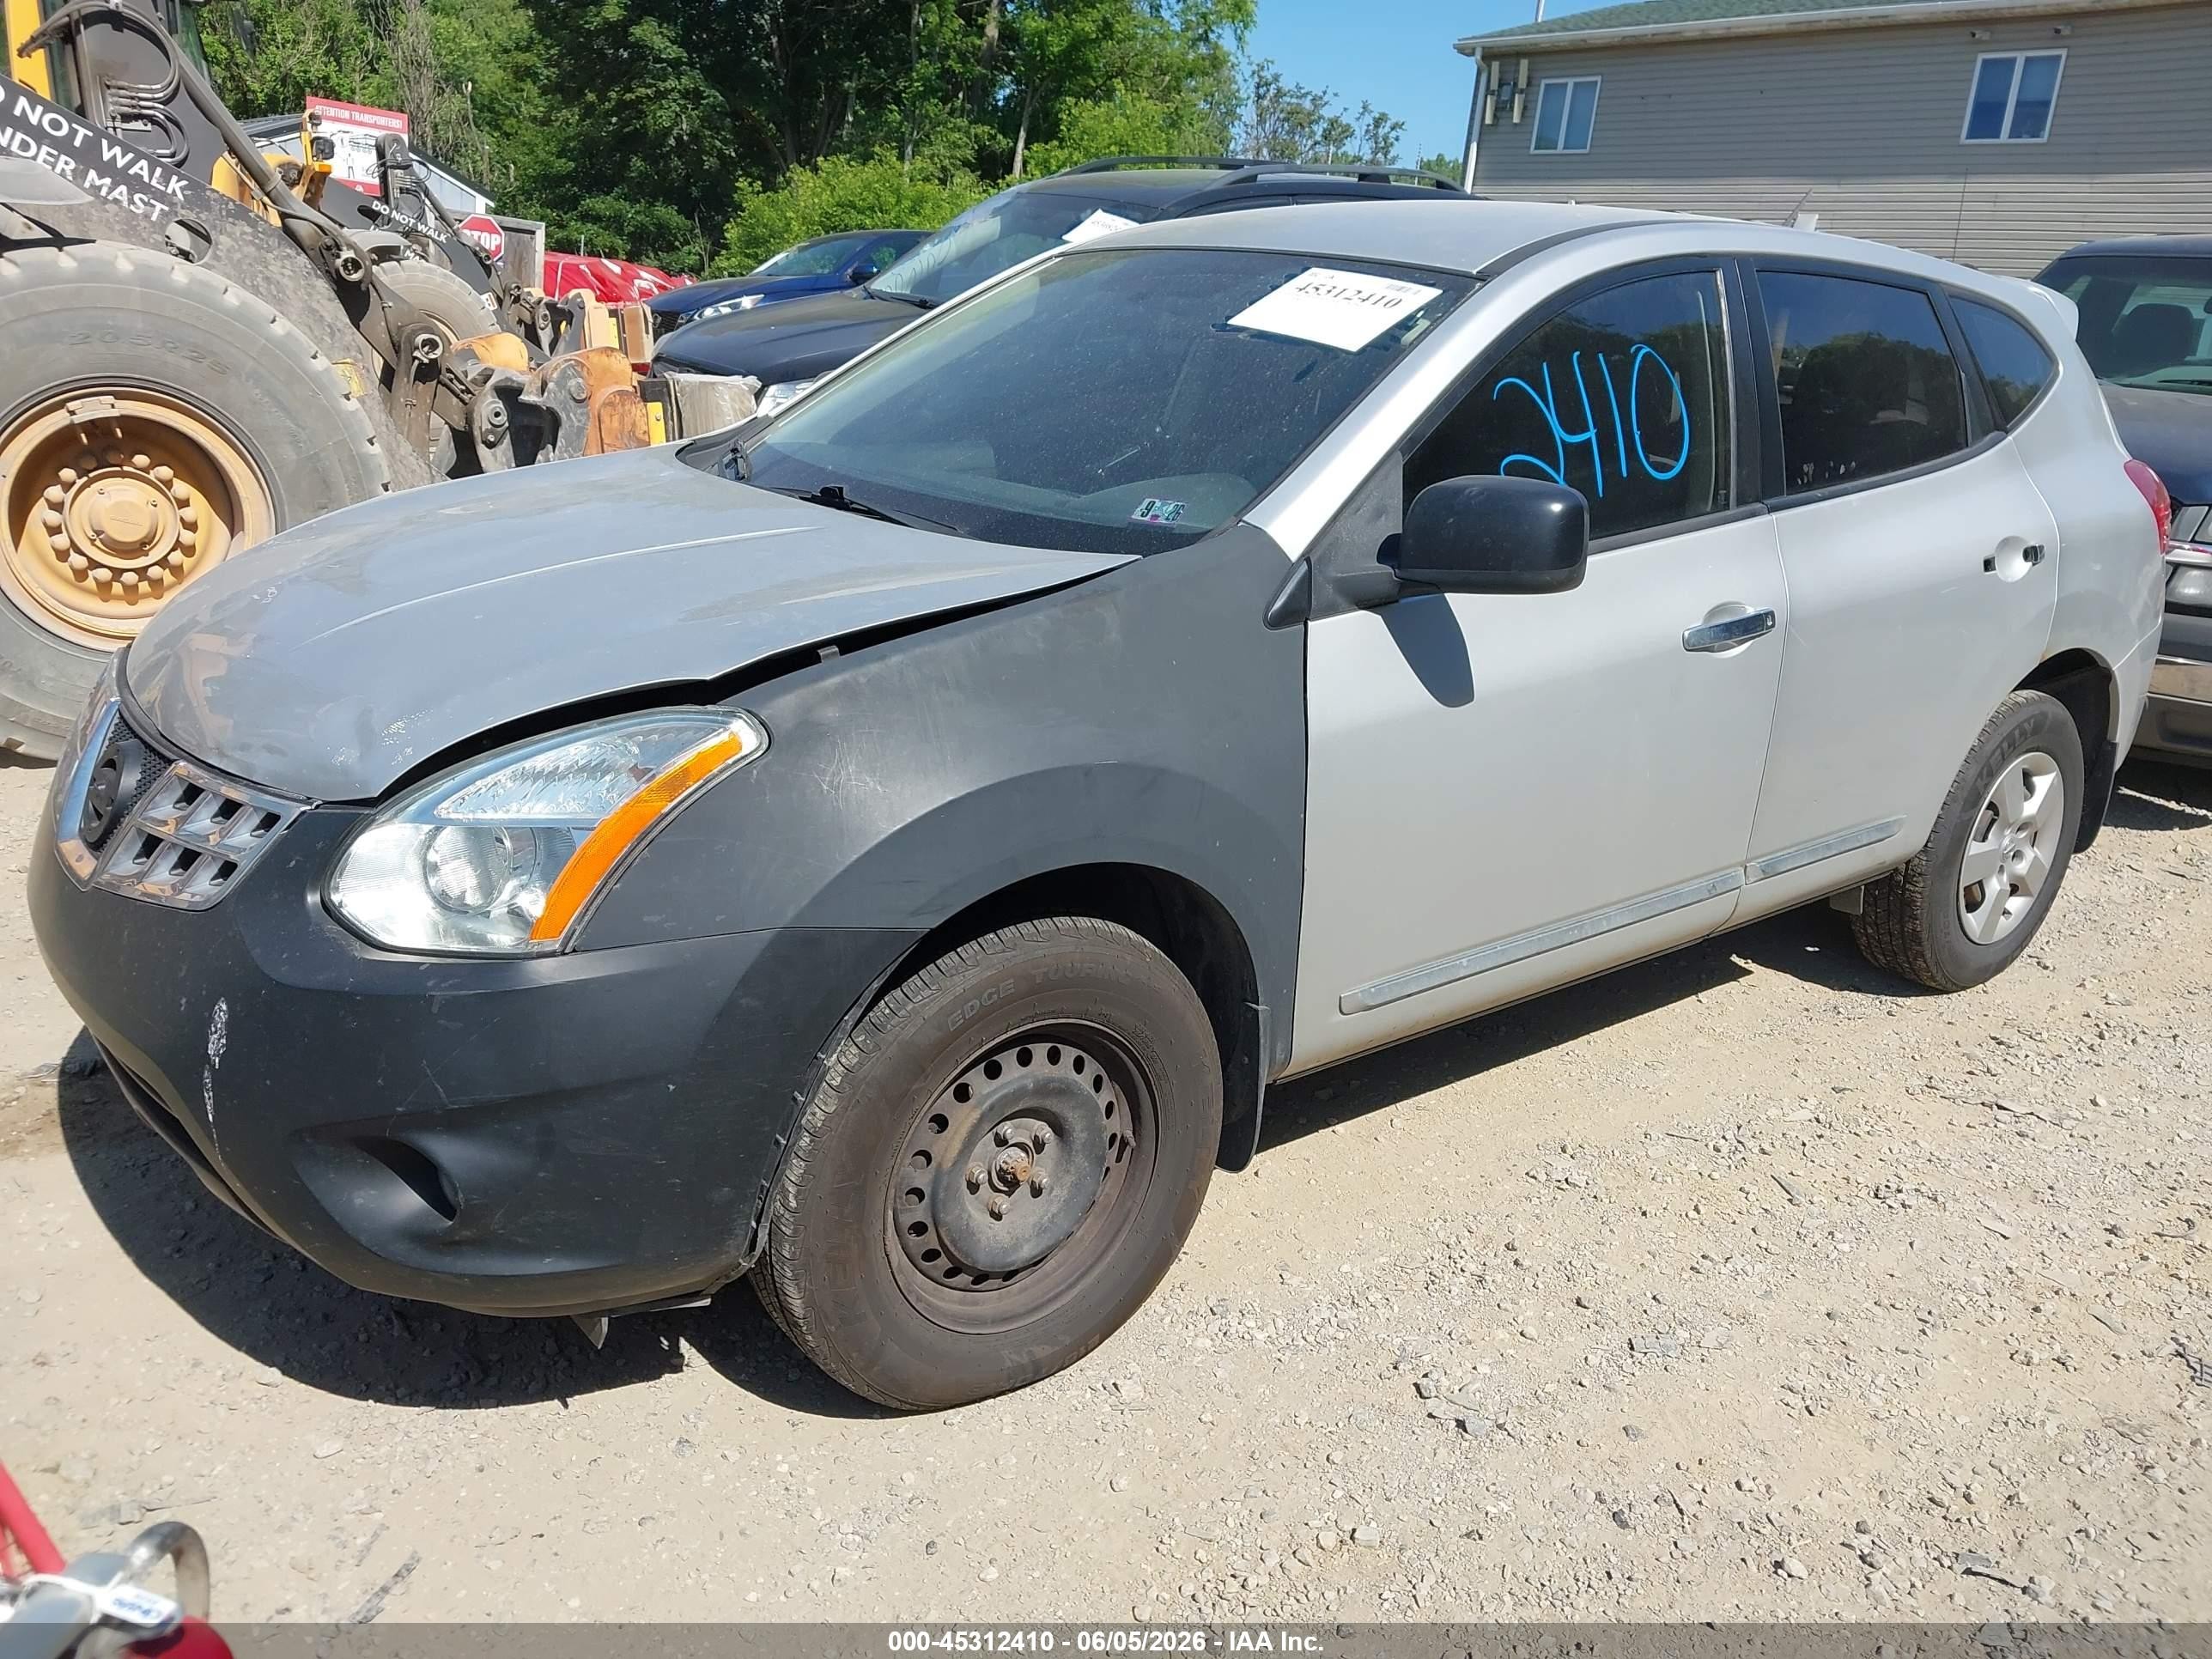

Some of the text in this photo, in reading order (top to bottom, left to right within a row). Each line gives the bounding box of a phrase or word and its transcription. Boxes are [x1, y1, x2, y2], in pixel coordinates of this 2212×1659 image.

[315, 105, 403, 129] ATTENTION TRANSPORTERS!
[14, 95, 189, 201] NOT WALK
[0, 126, 169, 222] NDER MAST
[372, 201, 447, 244] DO NOT WALK
[1295, 282, 1403, 309] 45312410
[1493, 343, 1690, 498] 2410
[1139, 500, 1156, 518] 9
[947, 979, 1015, 1030] EDGE
